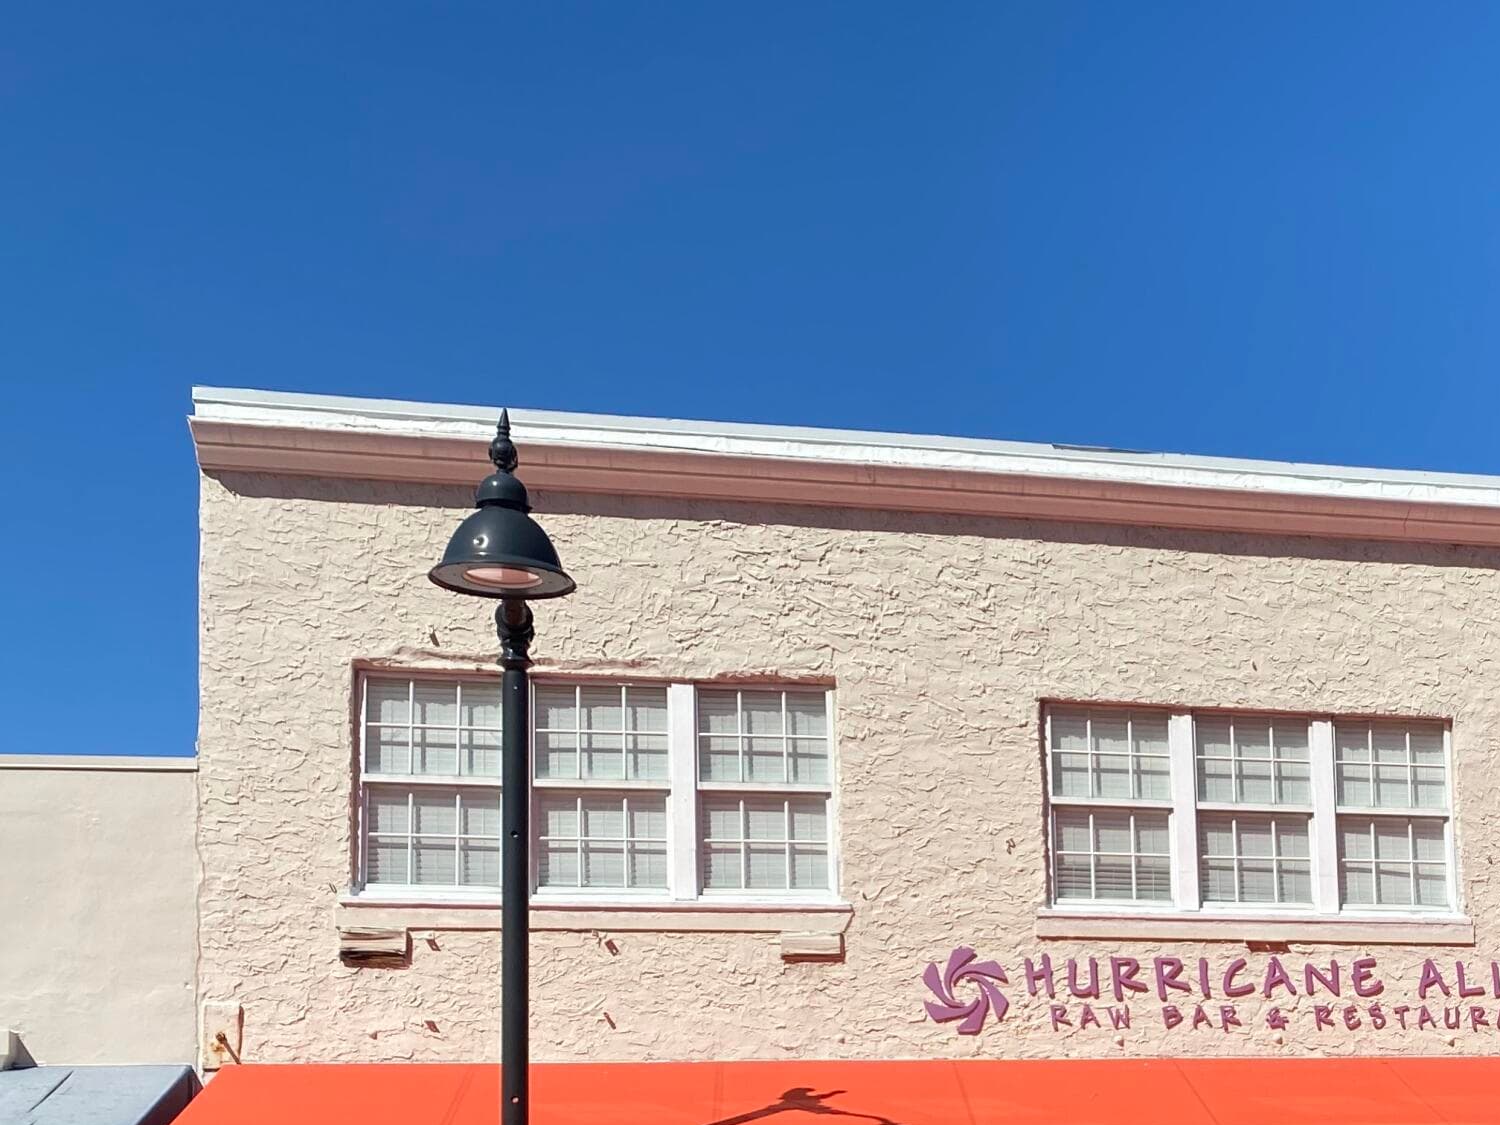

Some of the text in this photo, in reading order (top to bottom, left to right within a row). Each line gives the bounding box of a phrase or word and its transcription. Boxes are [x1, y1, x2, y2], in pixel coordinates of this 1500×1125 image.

[1024, 953, 1384, 1002] HURRICANE
[1050, 1004, 1131, 1032] RAW
[1162, 1005, 1243, 1033] BAR
[1266, 1007, 1289, 1030] &
